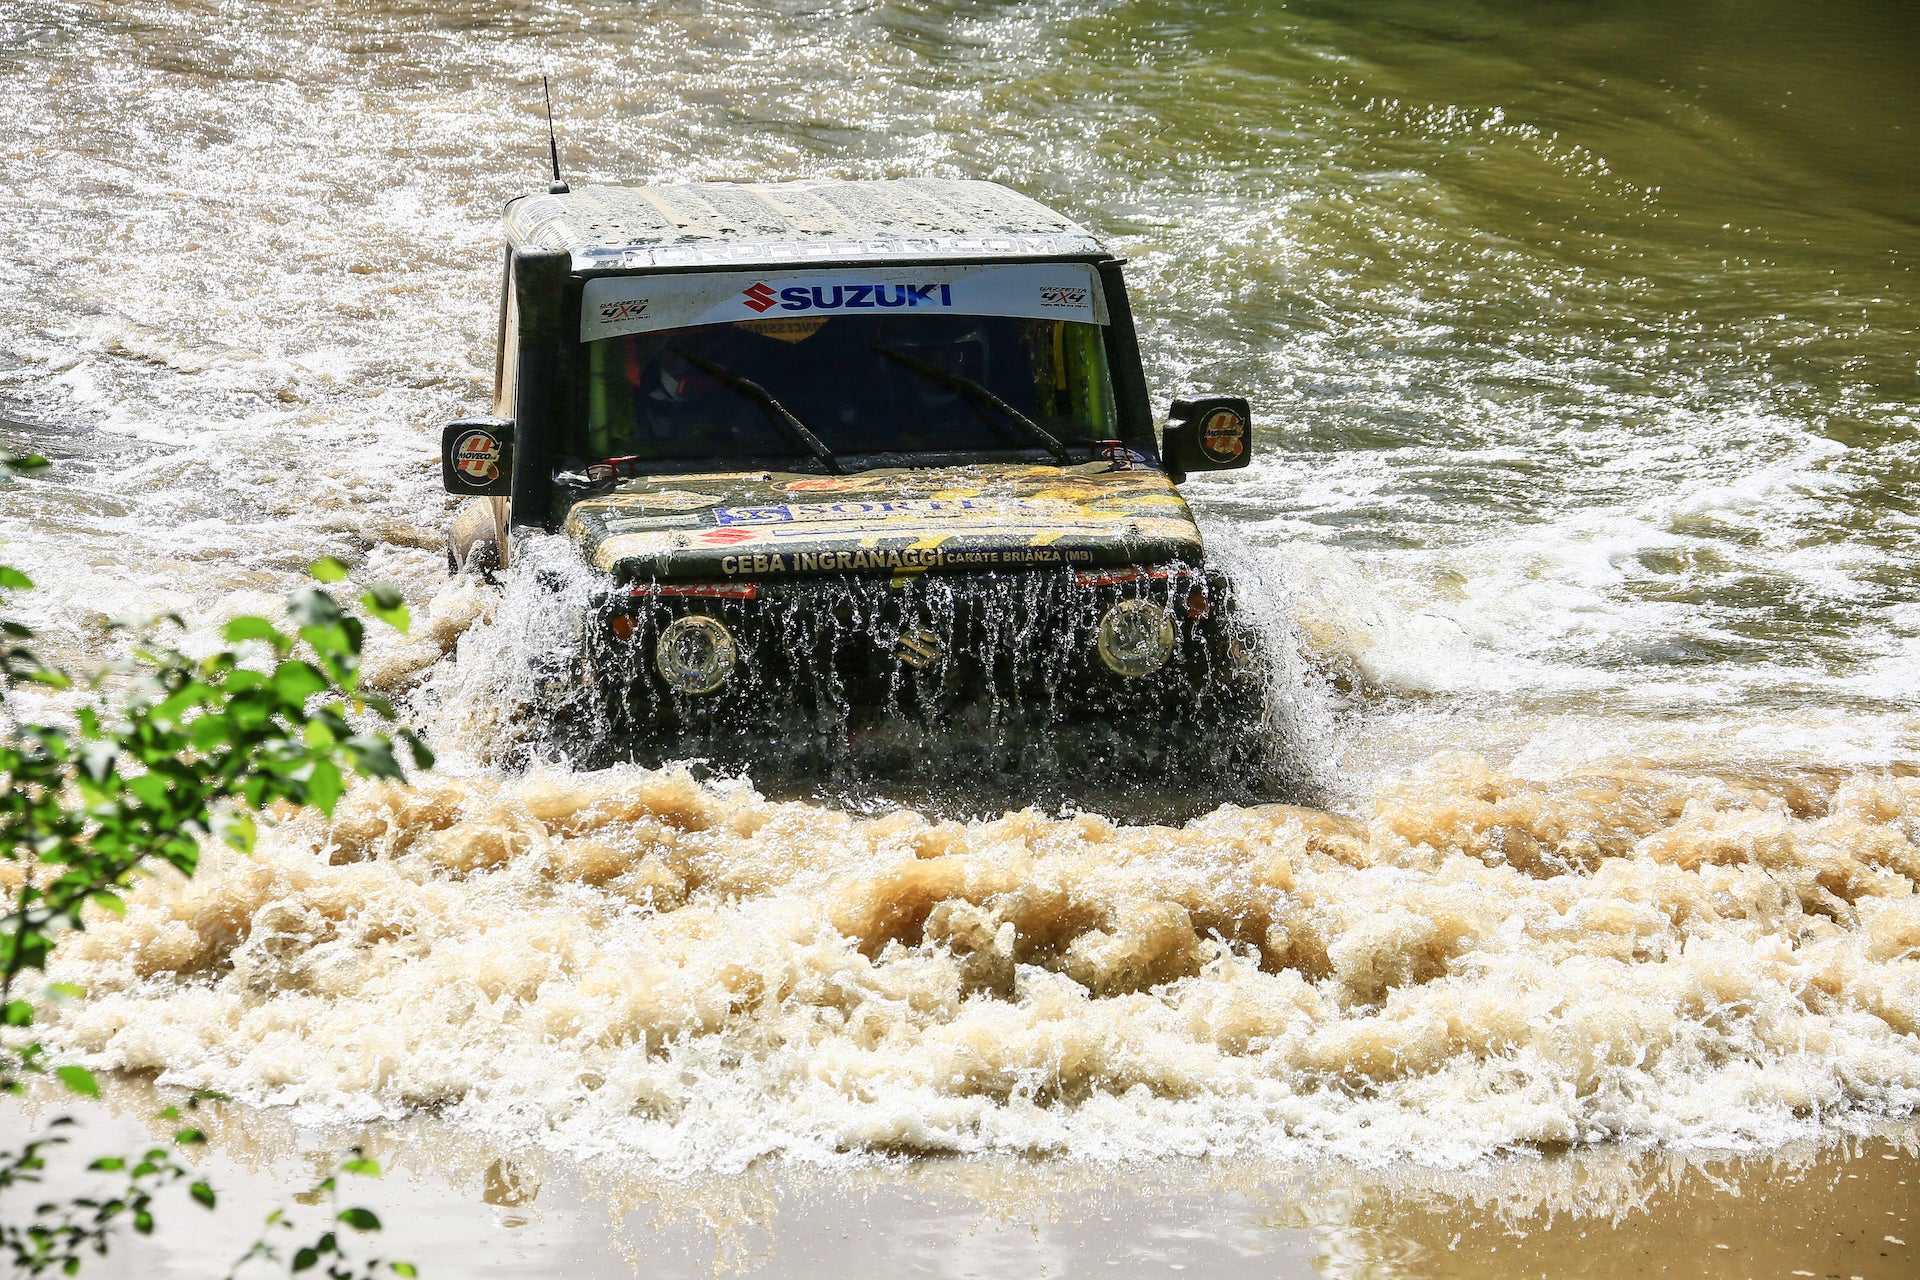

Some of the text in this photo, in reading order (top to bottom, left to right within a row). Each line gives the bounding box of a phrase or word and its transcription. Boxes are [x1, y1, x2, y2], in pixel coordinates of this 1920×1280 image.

[780, 283, 952, 311] SUZUKI
[458, 452, 492, 460] MOVECO
[721, 548, 1094, 574] CEBA INGRANAGGI CARATE BRIANZA (MB)
